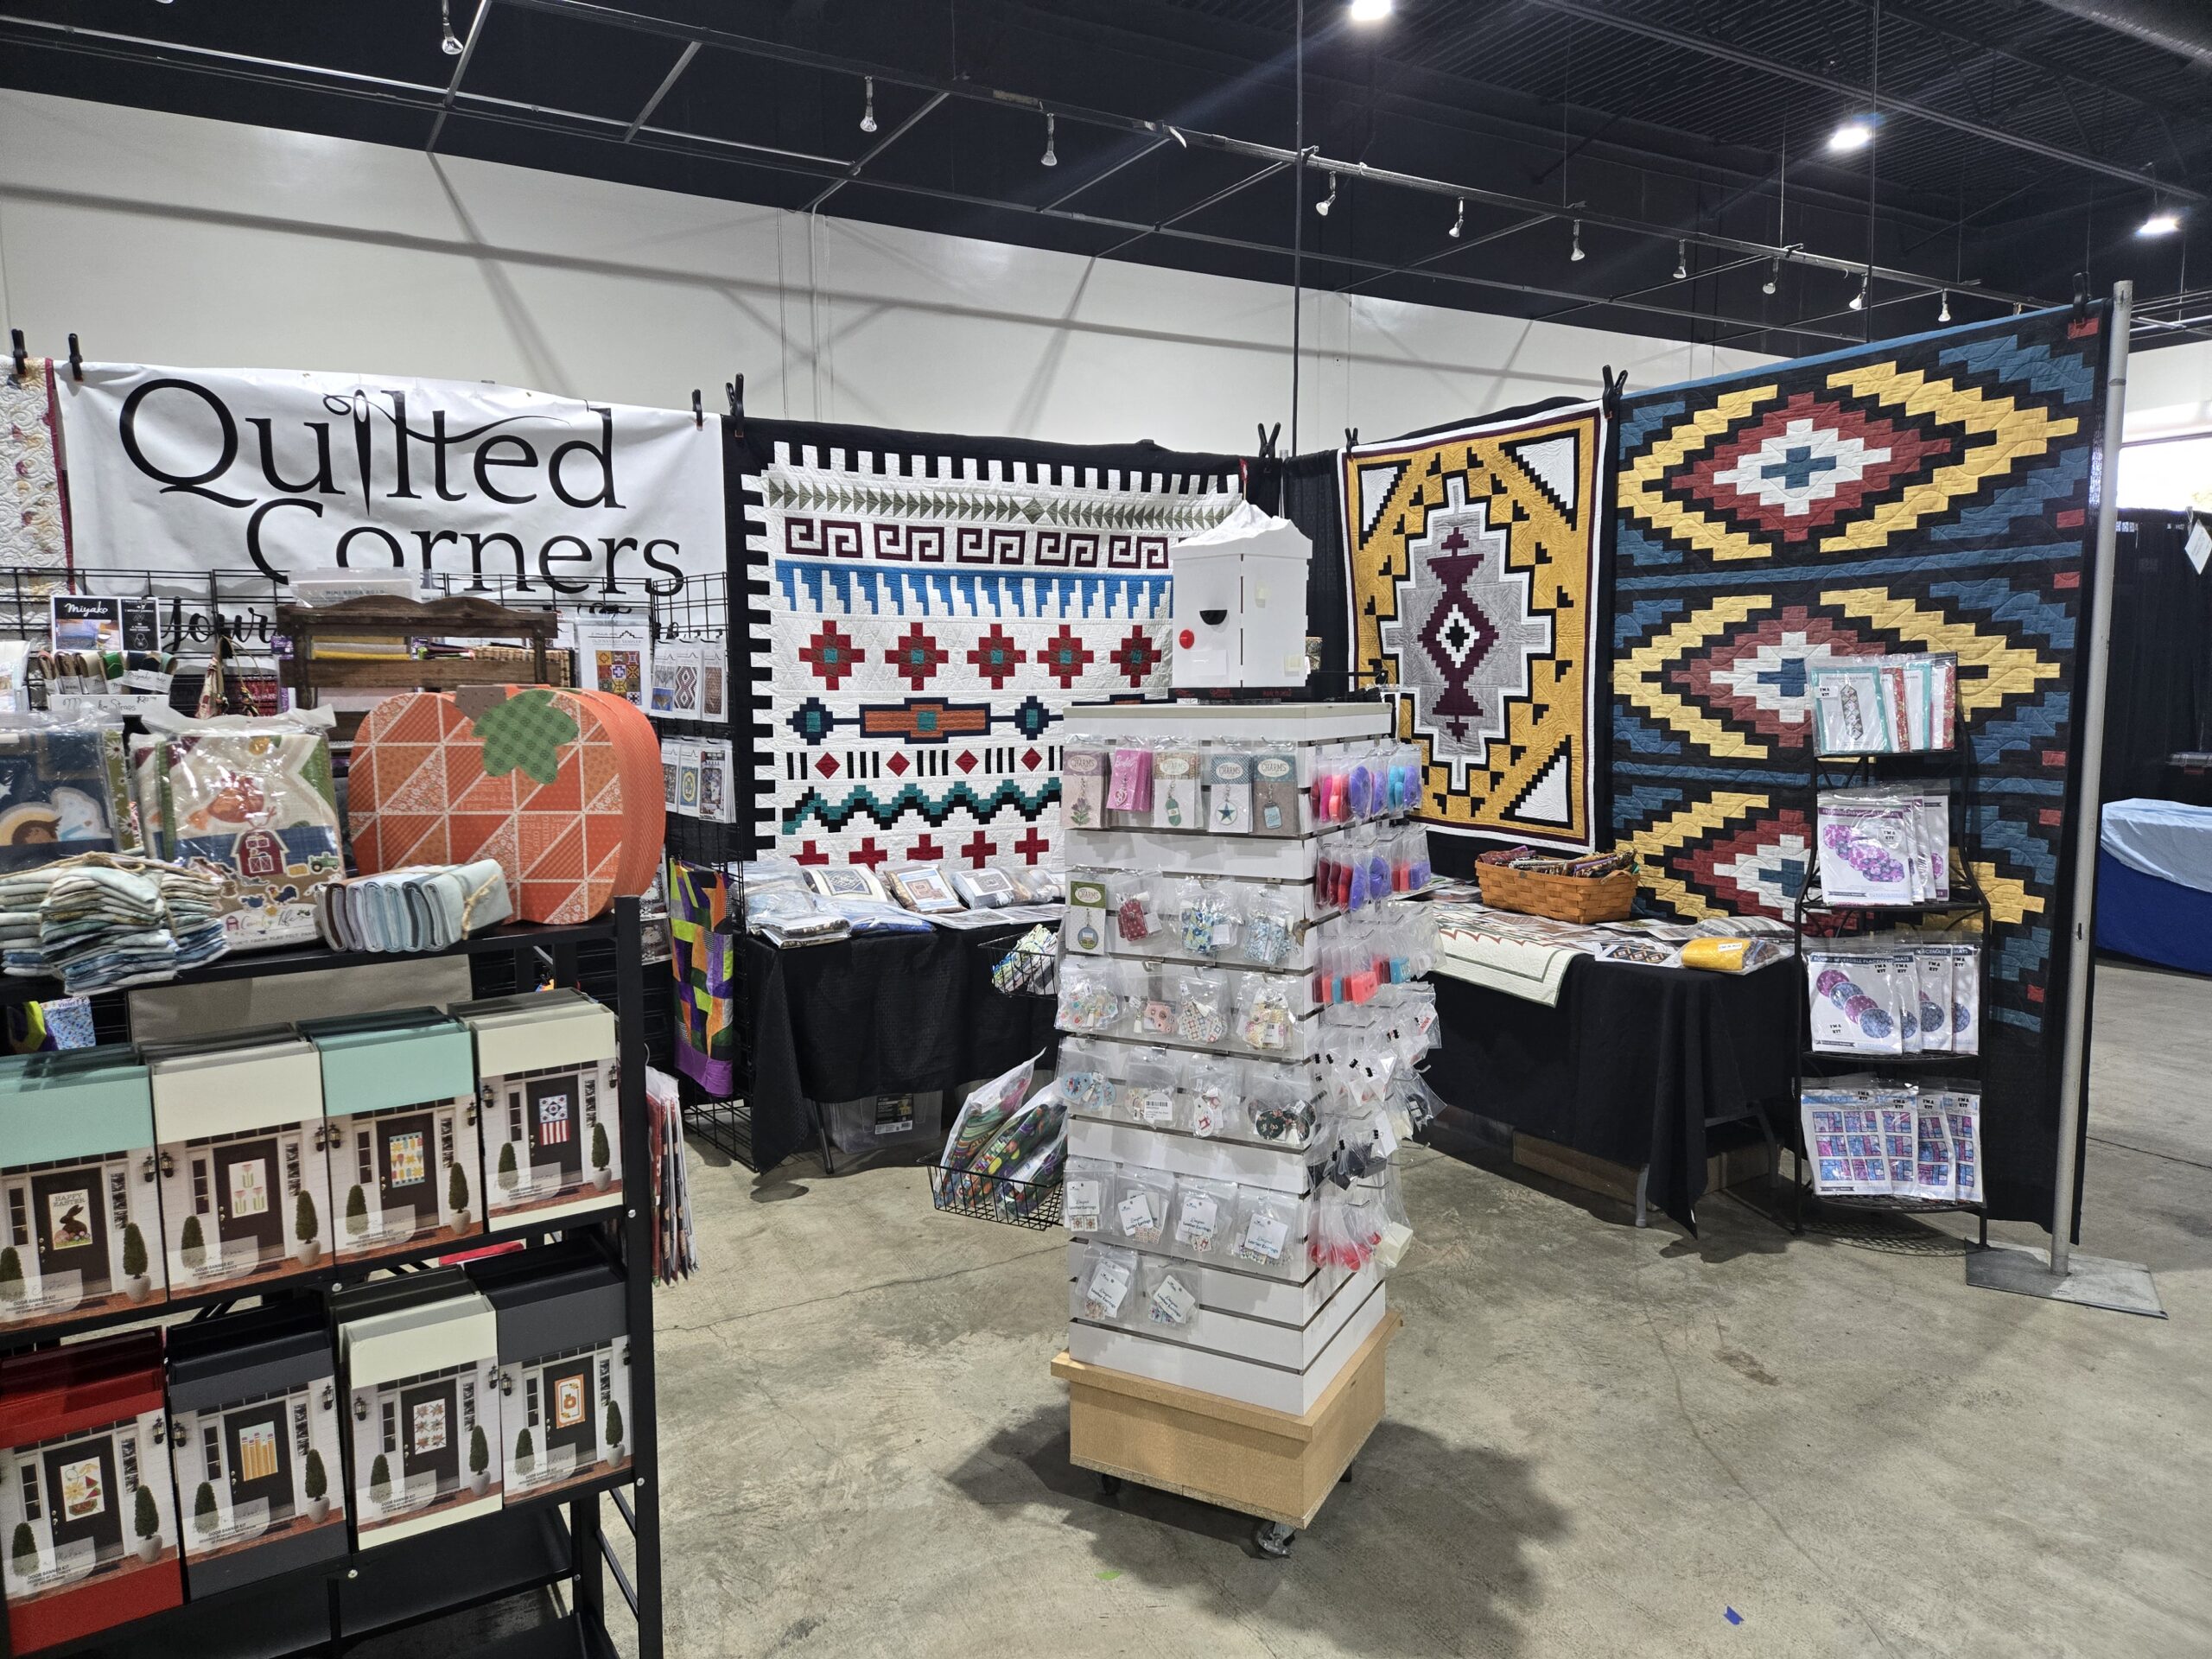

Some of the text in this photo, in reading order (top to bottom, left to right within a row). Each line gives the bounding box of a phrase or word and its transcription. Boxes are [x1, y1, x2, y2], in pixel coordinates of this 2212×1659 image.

[119, 378, 626, 517] Quilted
[246, 498, 683, 596] Corners
[65, 601, 109, 617] Miyako
[1261, 762, 1287, 772] CHARMS
[1077, 891, 1099, 899] CHARMS
[54, 1192, 83, 1202] HAPPY
[54, 1198, 85, 1207] EASTER
[1090, 1288, 1116, 1308] Leather Earrings
[1157, 1294, 1181, 1317] Leather Earrings
